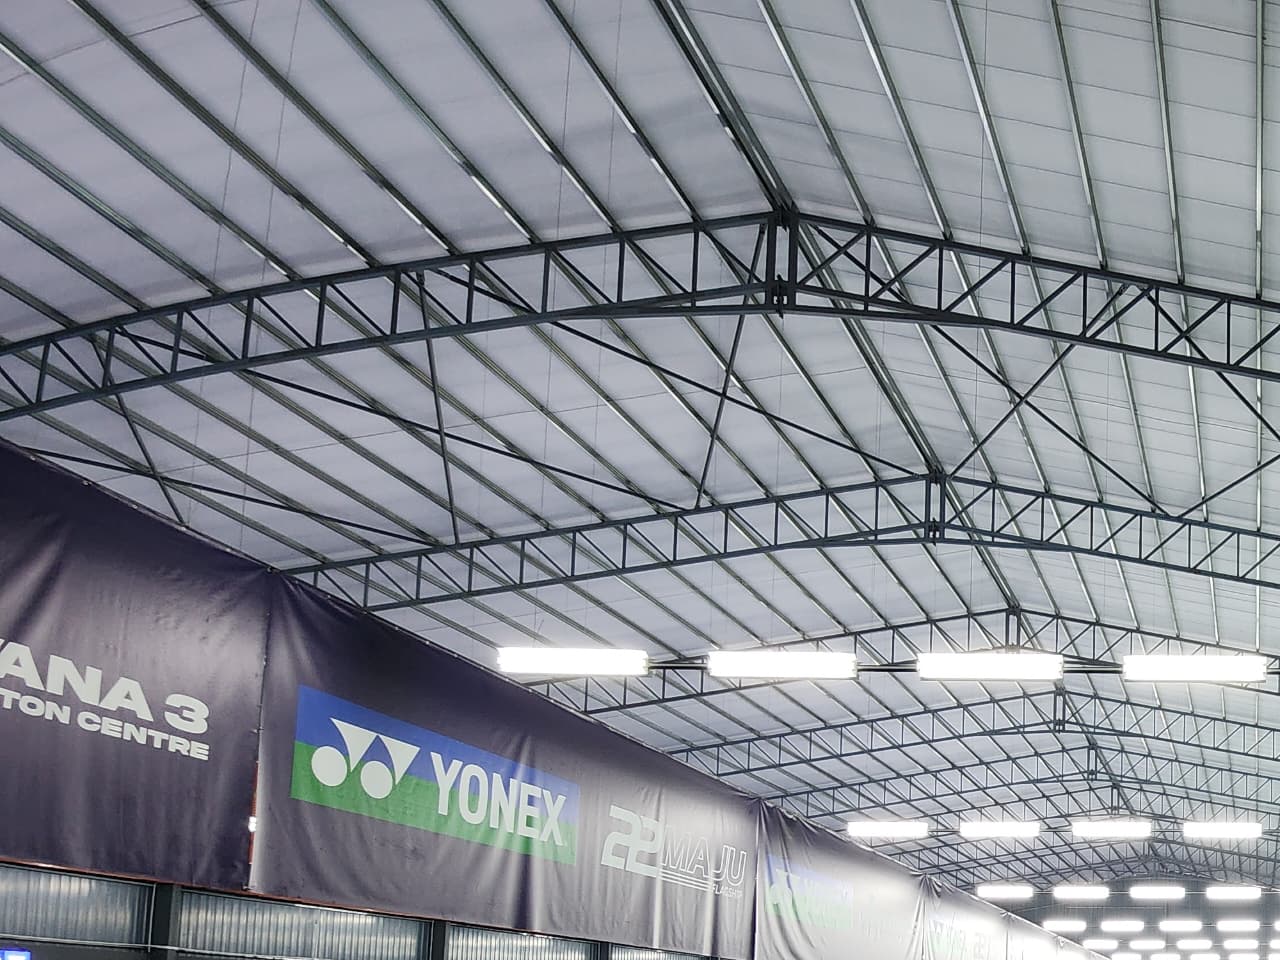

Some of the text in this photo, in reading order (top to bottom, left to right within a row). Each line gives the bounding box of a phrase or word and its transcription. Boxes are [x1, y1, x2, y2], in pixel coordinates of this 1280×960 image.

[0, 638, 210, 734] ANA 3
[77, 711, 210, 761] CENTRE
[430, 751, 566, 847] YONEX
[661, 824, 747, 886] MAJU
